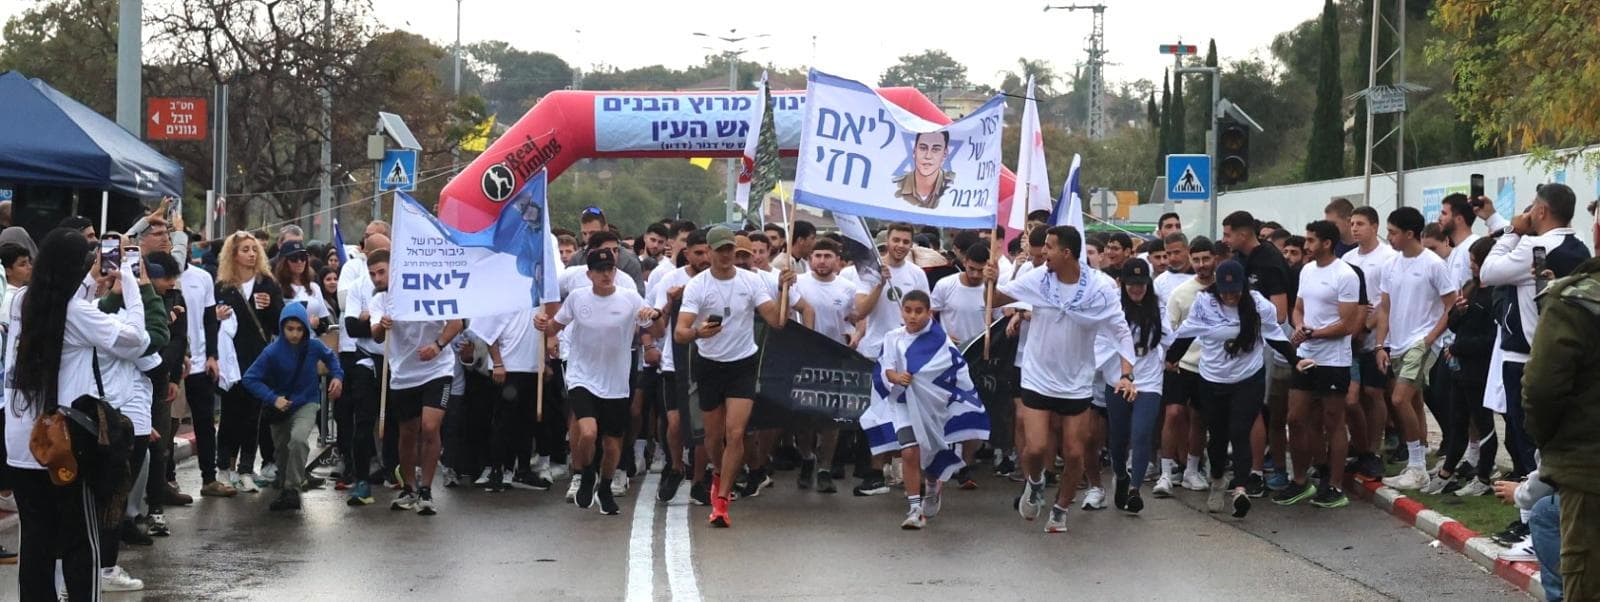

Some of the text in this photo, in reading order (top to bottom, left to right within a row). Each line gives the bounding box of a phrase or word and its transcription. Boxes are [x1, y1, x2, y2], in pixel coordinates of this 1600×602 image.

[603, 97, 679, 112] הבנים
[688, 97, 752, 114] מרוץ
[171, 112, 193, 123] יובל
[166, 125, 198, 135] גוונים
[652, 120, 750, 142] אש העין
[816, 107, 896, 150] ליאם
[505, 134, 540, 170] Real
[968, 136, 986, 161] של
[515, 138, 562, 181] Timing
[816, 146, 871, 189] חזי
[405, 246, 465, 257] גיבור ישראל
[402, 269, 471, 290] ליאם
[414, 299, 458, 316] חזי
